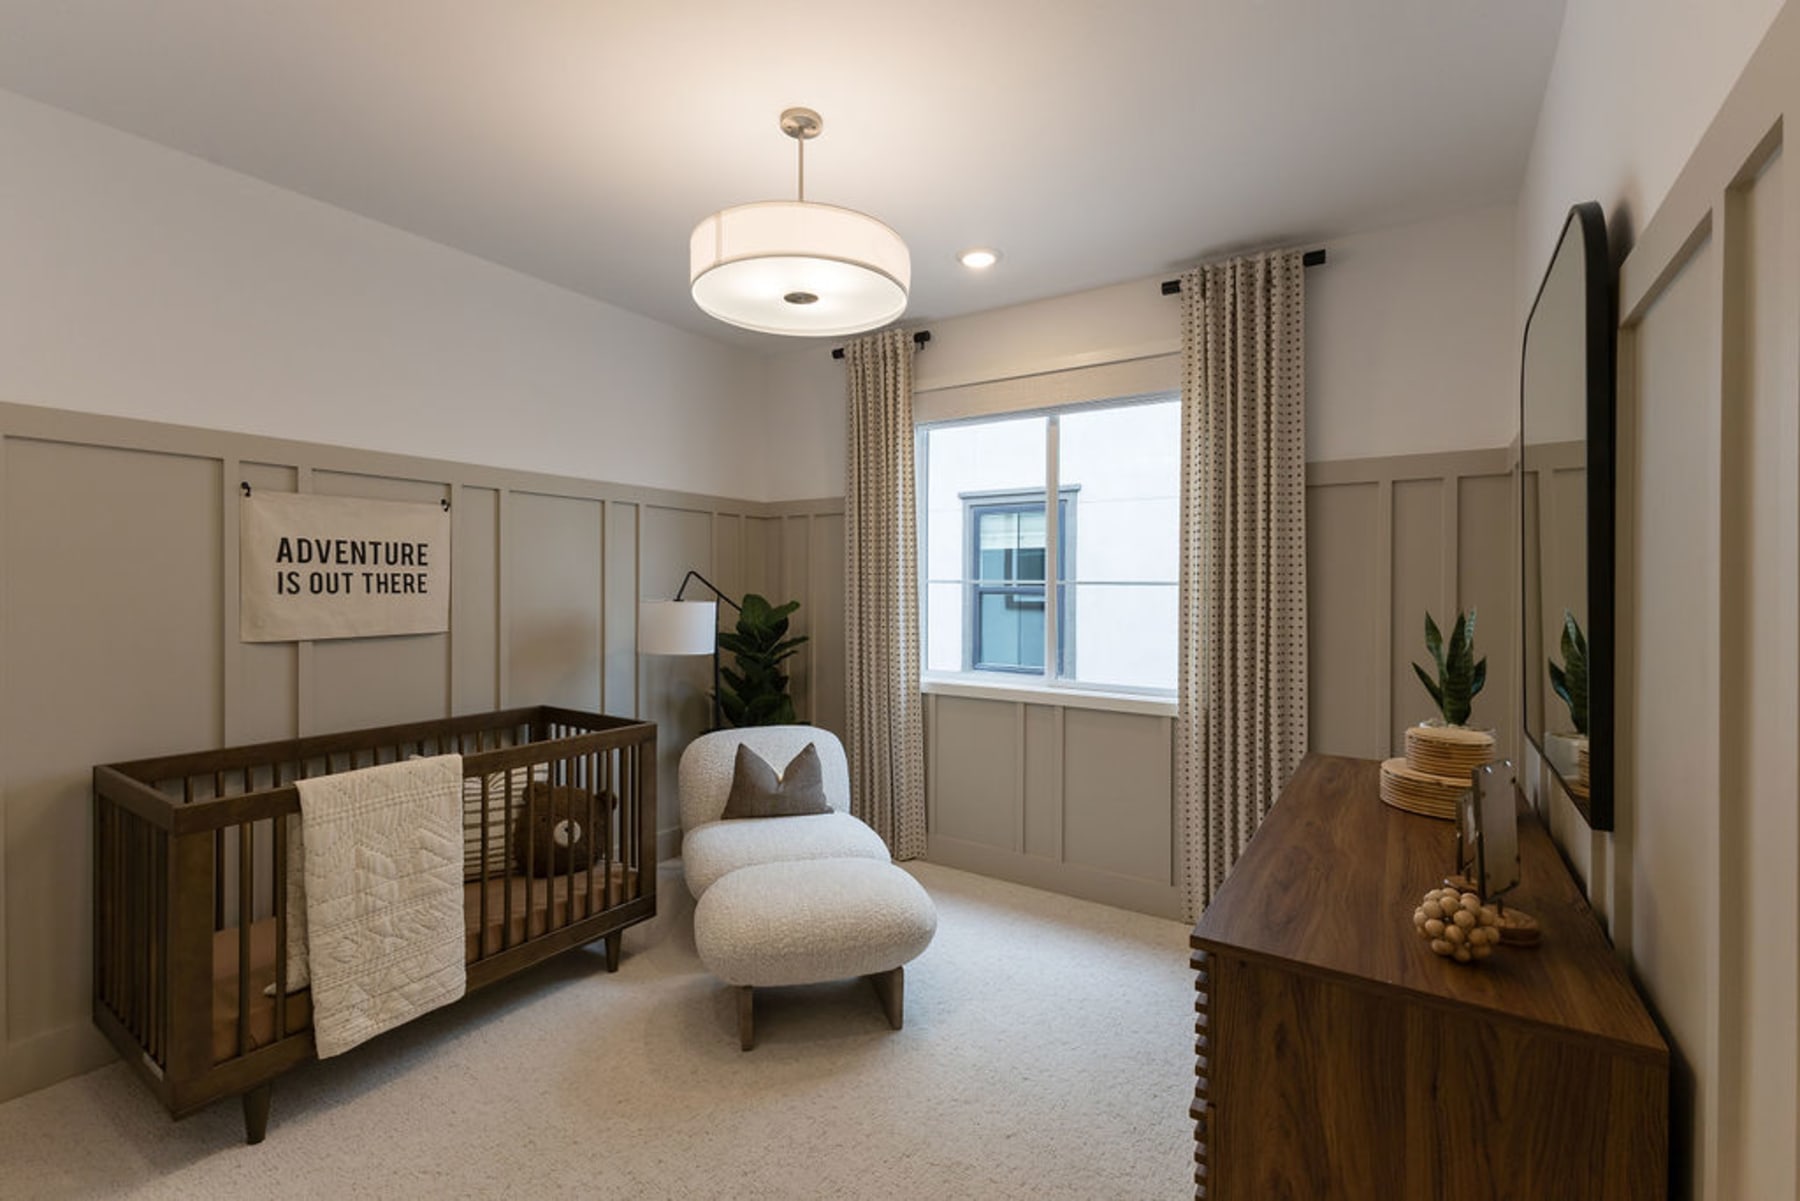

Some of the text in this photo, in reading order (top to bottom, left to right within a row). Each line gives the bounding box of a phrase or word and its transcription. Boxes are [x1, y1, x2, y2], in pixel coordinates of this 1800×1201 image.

[276, 537, 429, 566] ADVENTURE
[277, 571, 428, 595] IS OUT THERE
